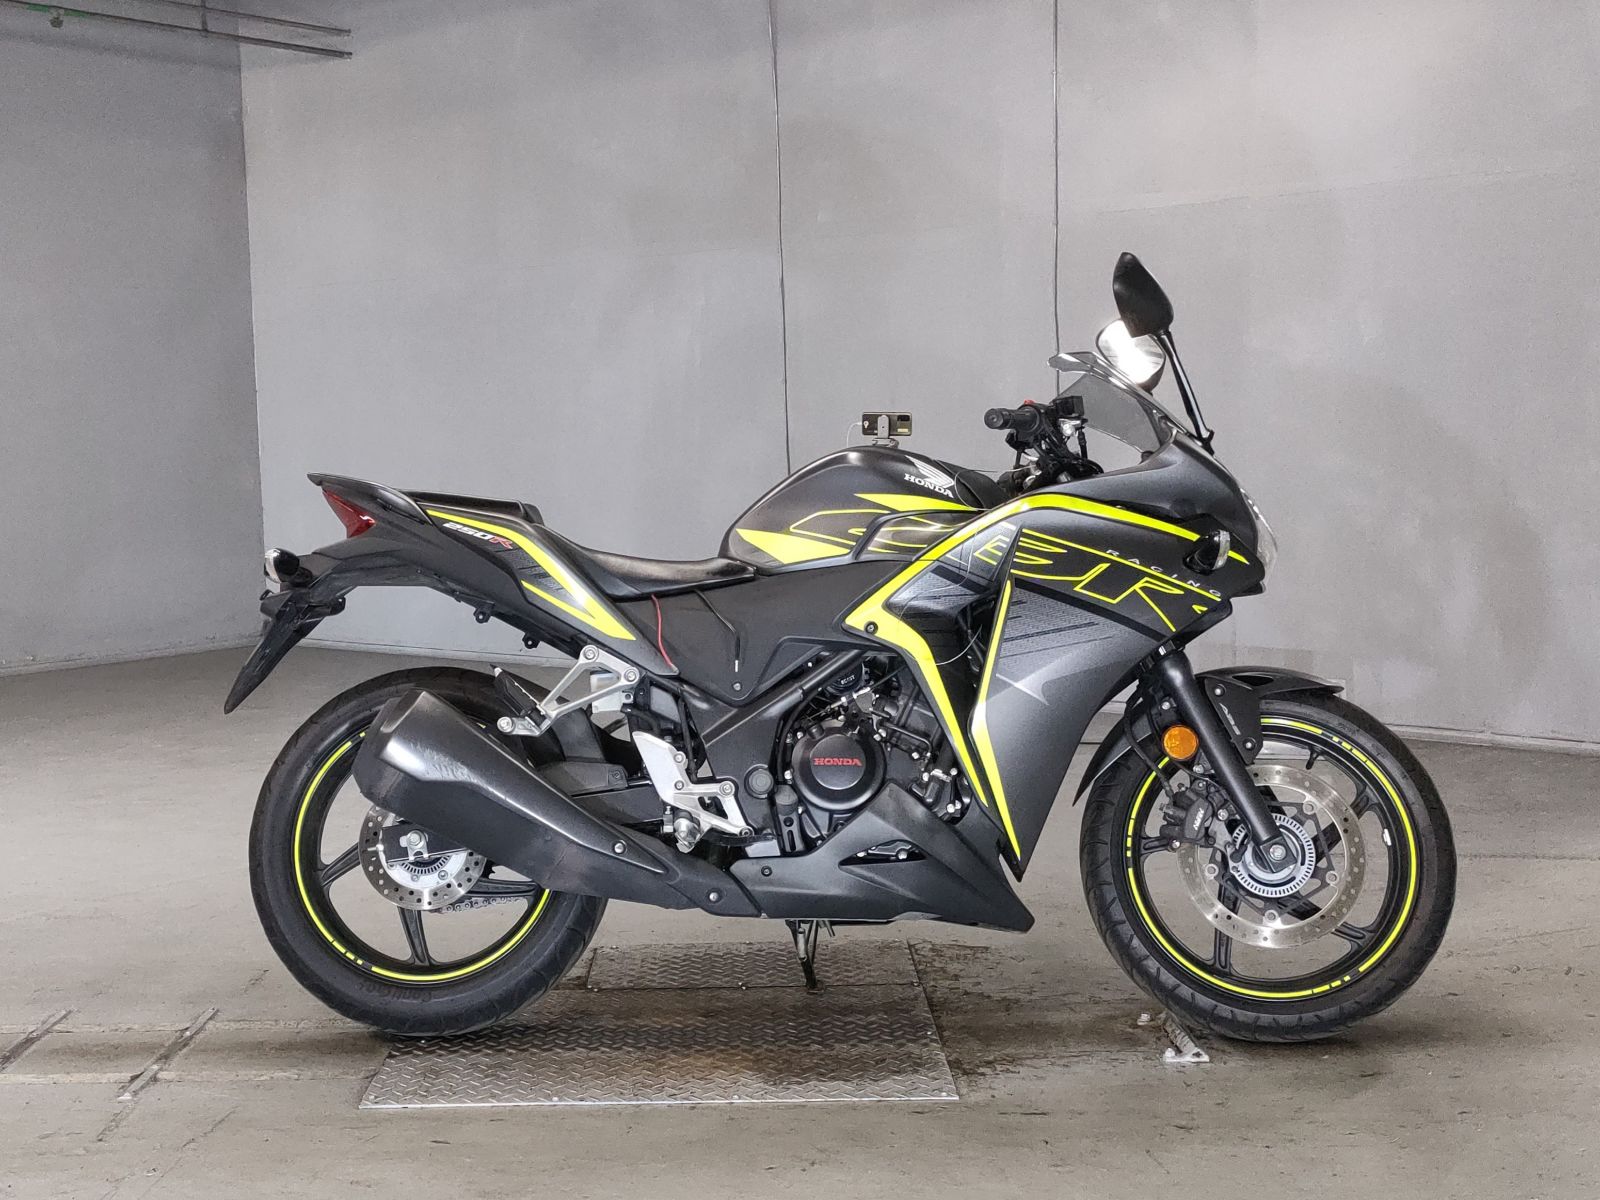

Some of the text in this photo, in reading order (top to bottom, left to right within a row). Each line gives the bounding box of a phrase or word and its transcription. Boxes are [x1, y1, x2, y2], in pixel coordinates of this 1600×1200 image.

[903, 473, 955, 498] HONDA
[442, 521, 514, 550] 250R
[1105, 549, 1222, 597] RACING
[813, 757, 863, 767] HONDA
